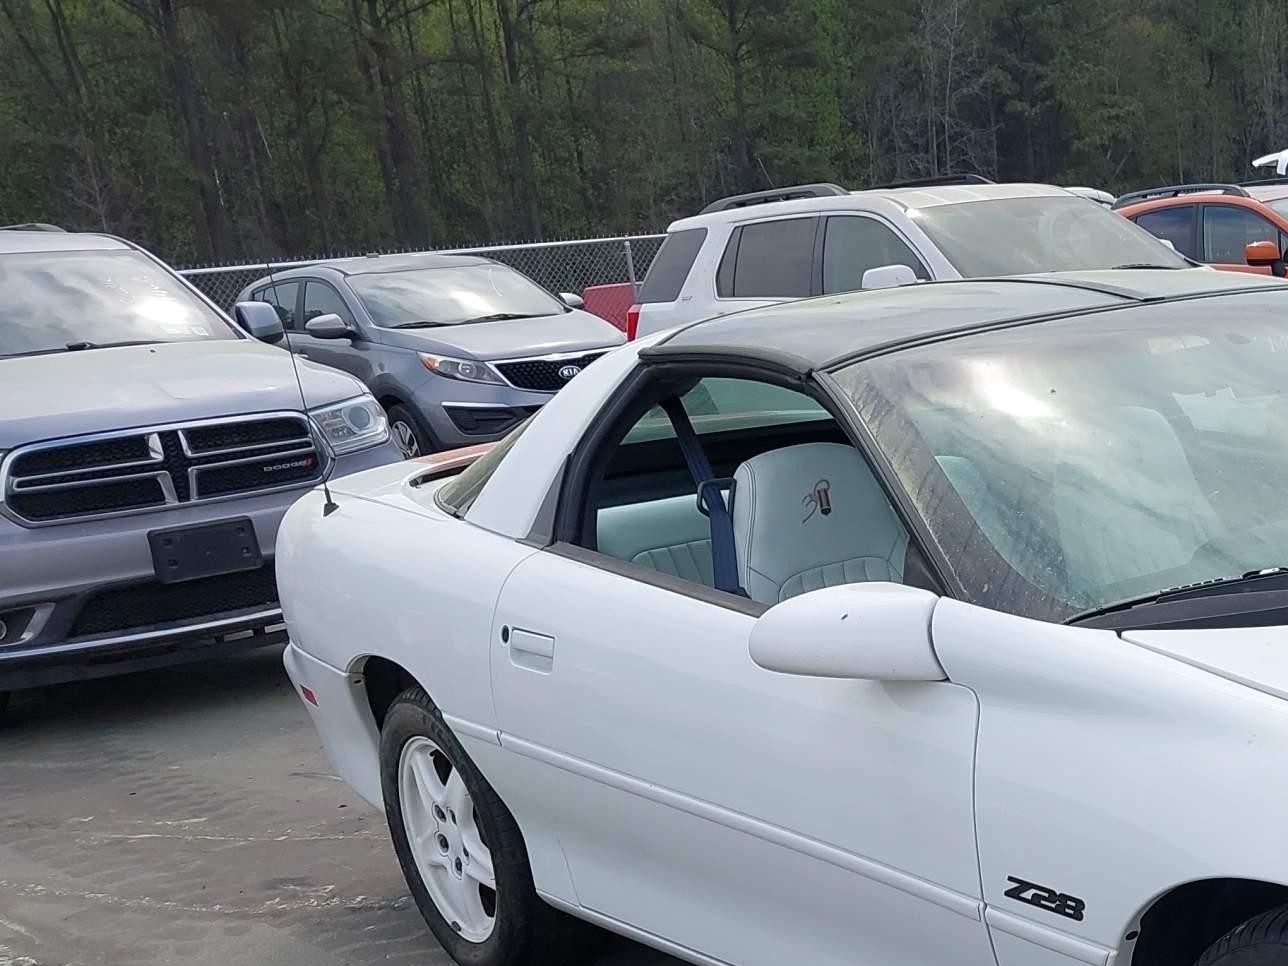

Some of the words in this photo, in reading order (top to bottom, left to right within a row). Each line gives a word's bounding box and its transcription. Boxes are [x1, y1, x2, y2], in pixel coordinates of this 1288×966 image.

[561, 367, 580, 377] KIA
[263, 460, 305, 472] DODGE
[1003, 875, 1086, 922] Z28
